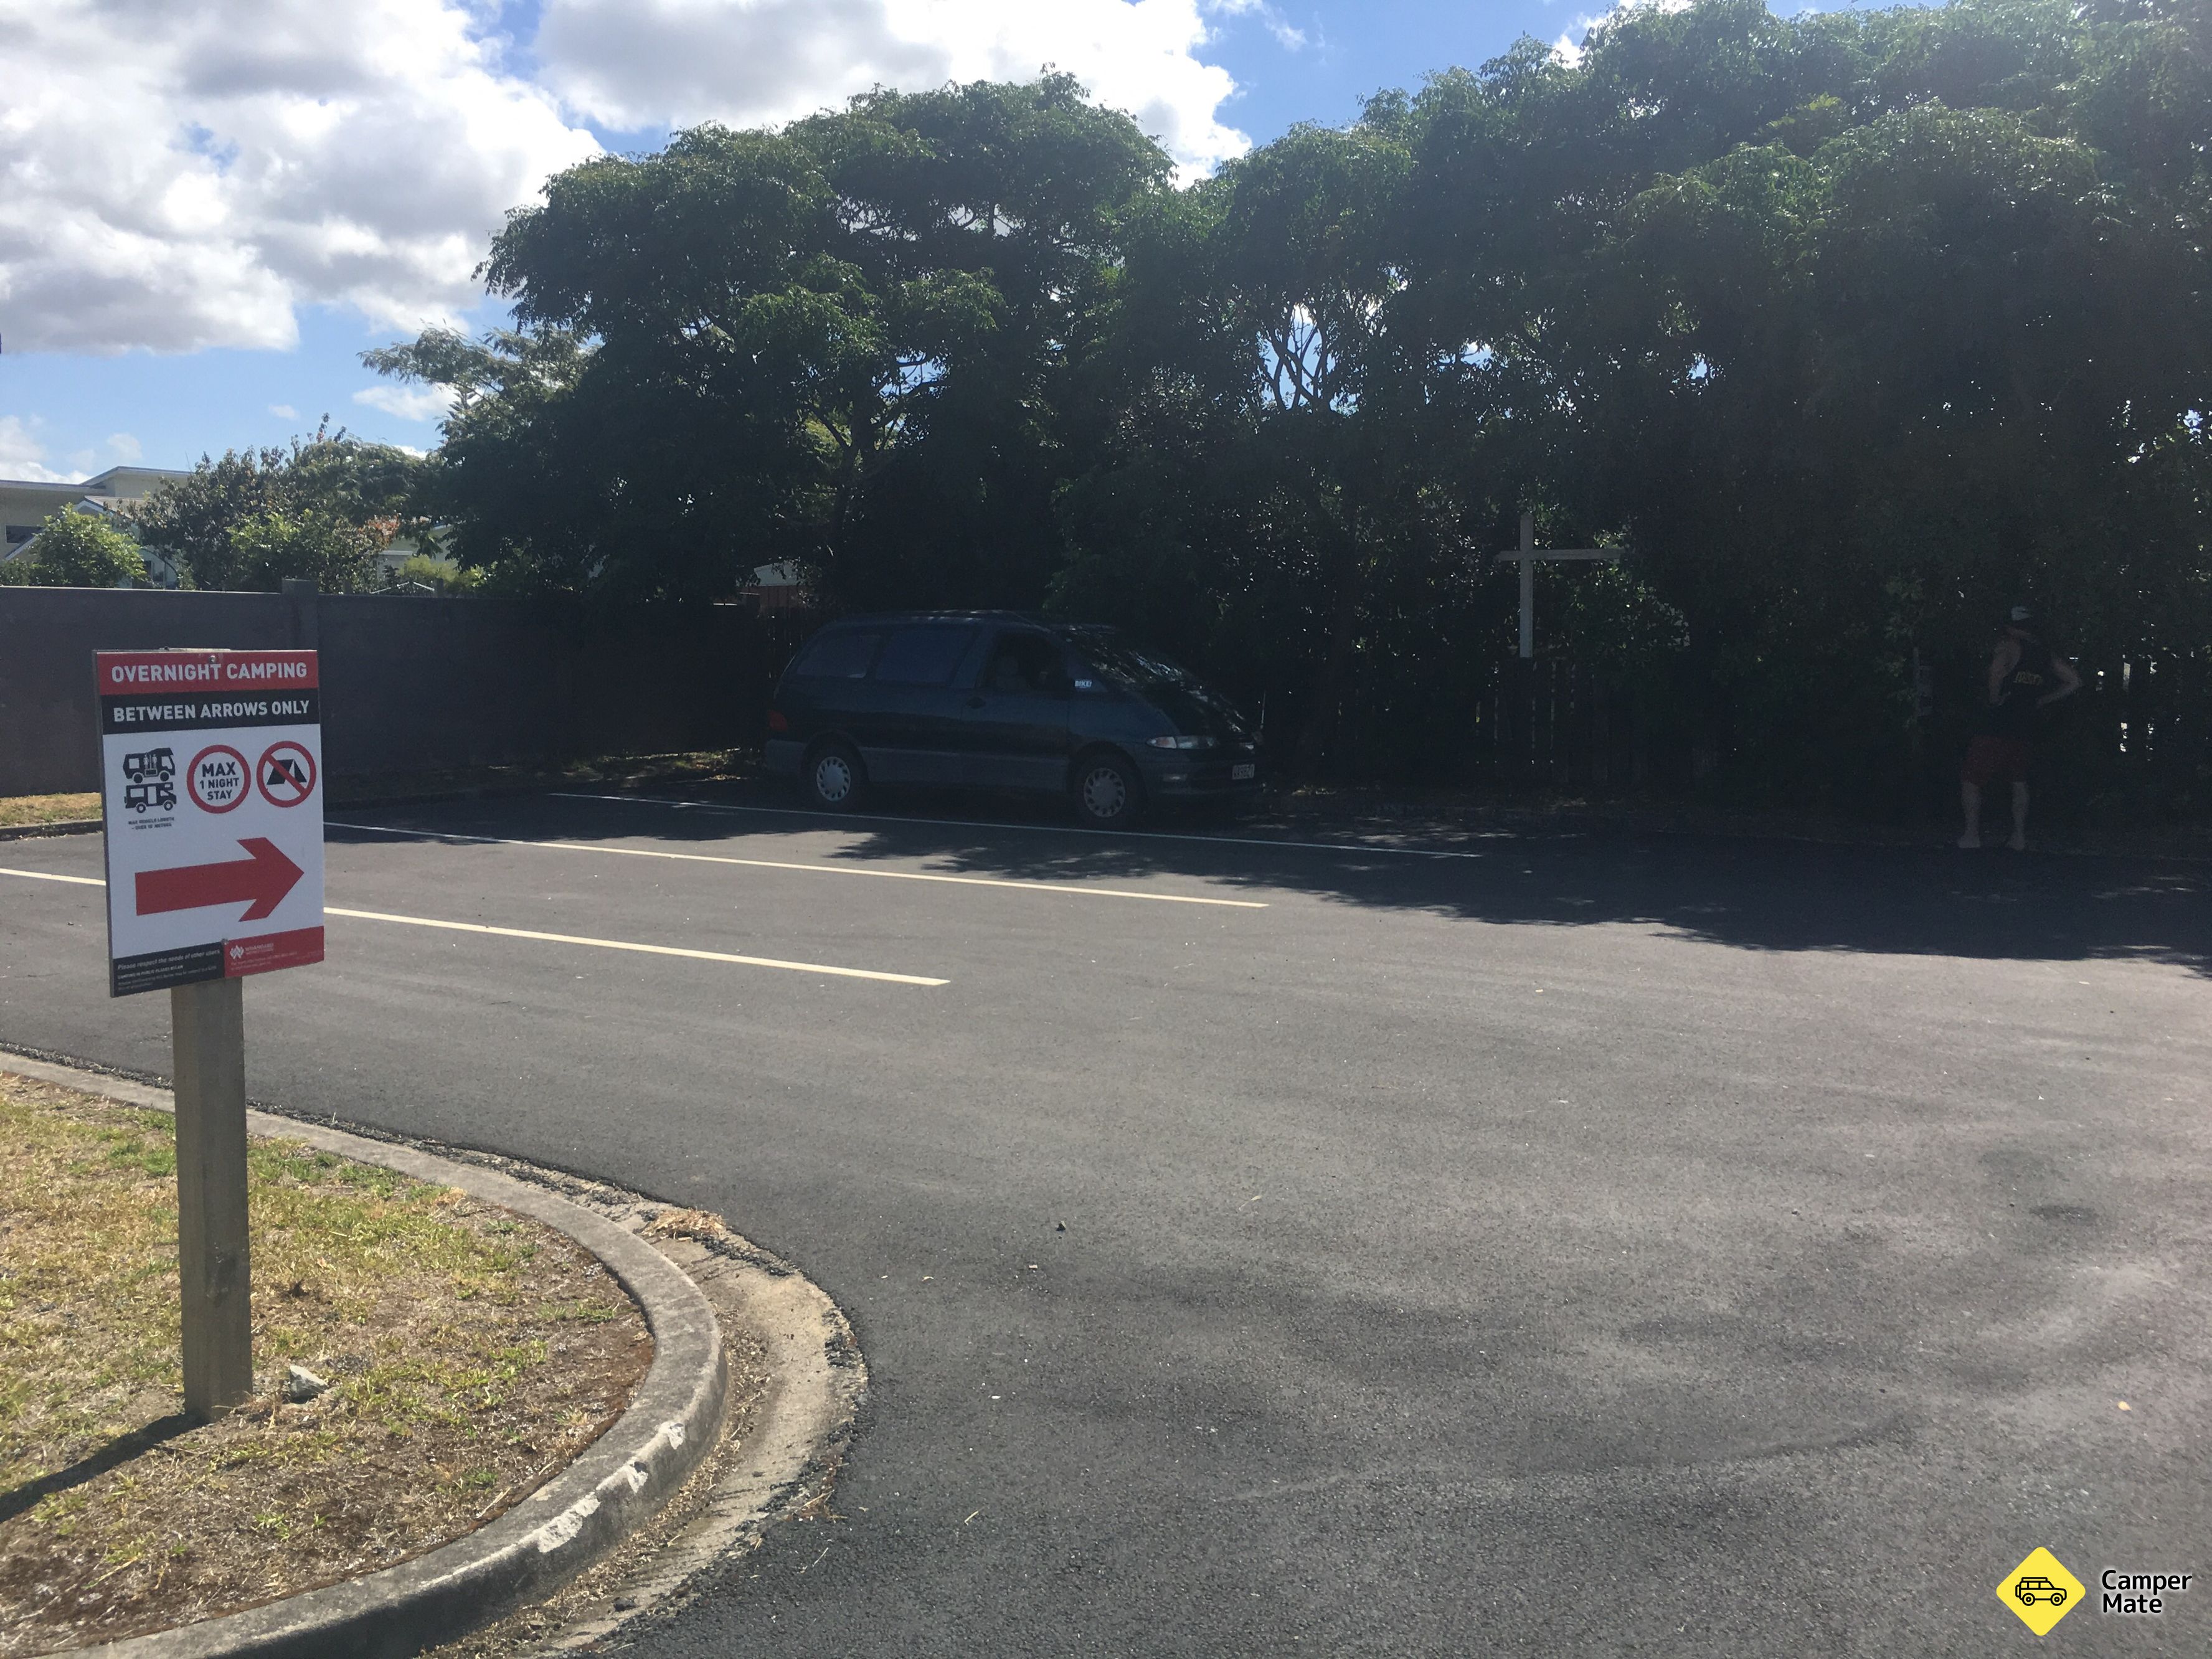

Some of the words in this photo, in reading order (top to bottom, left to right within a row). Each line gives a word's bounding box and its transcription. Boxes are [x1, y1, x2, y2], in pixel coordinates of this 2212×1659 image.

[111, 663, 221, 683] OVERNIGHT
[227, 662, 307, 679] CAMPING
[113, 704, 196, 722] BETWEEN
[200, 701, 268, 718] ARROWS
[272, 700, 310, 715] ONLY
[202, 762, 236, 777] MAX
[200, 780, 204, 790] 1
[208, 777, 239, 788] NIGHT
[207, 790, 232, 800] STAY
